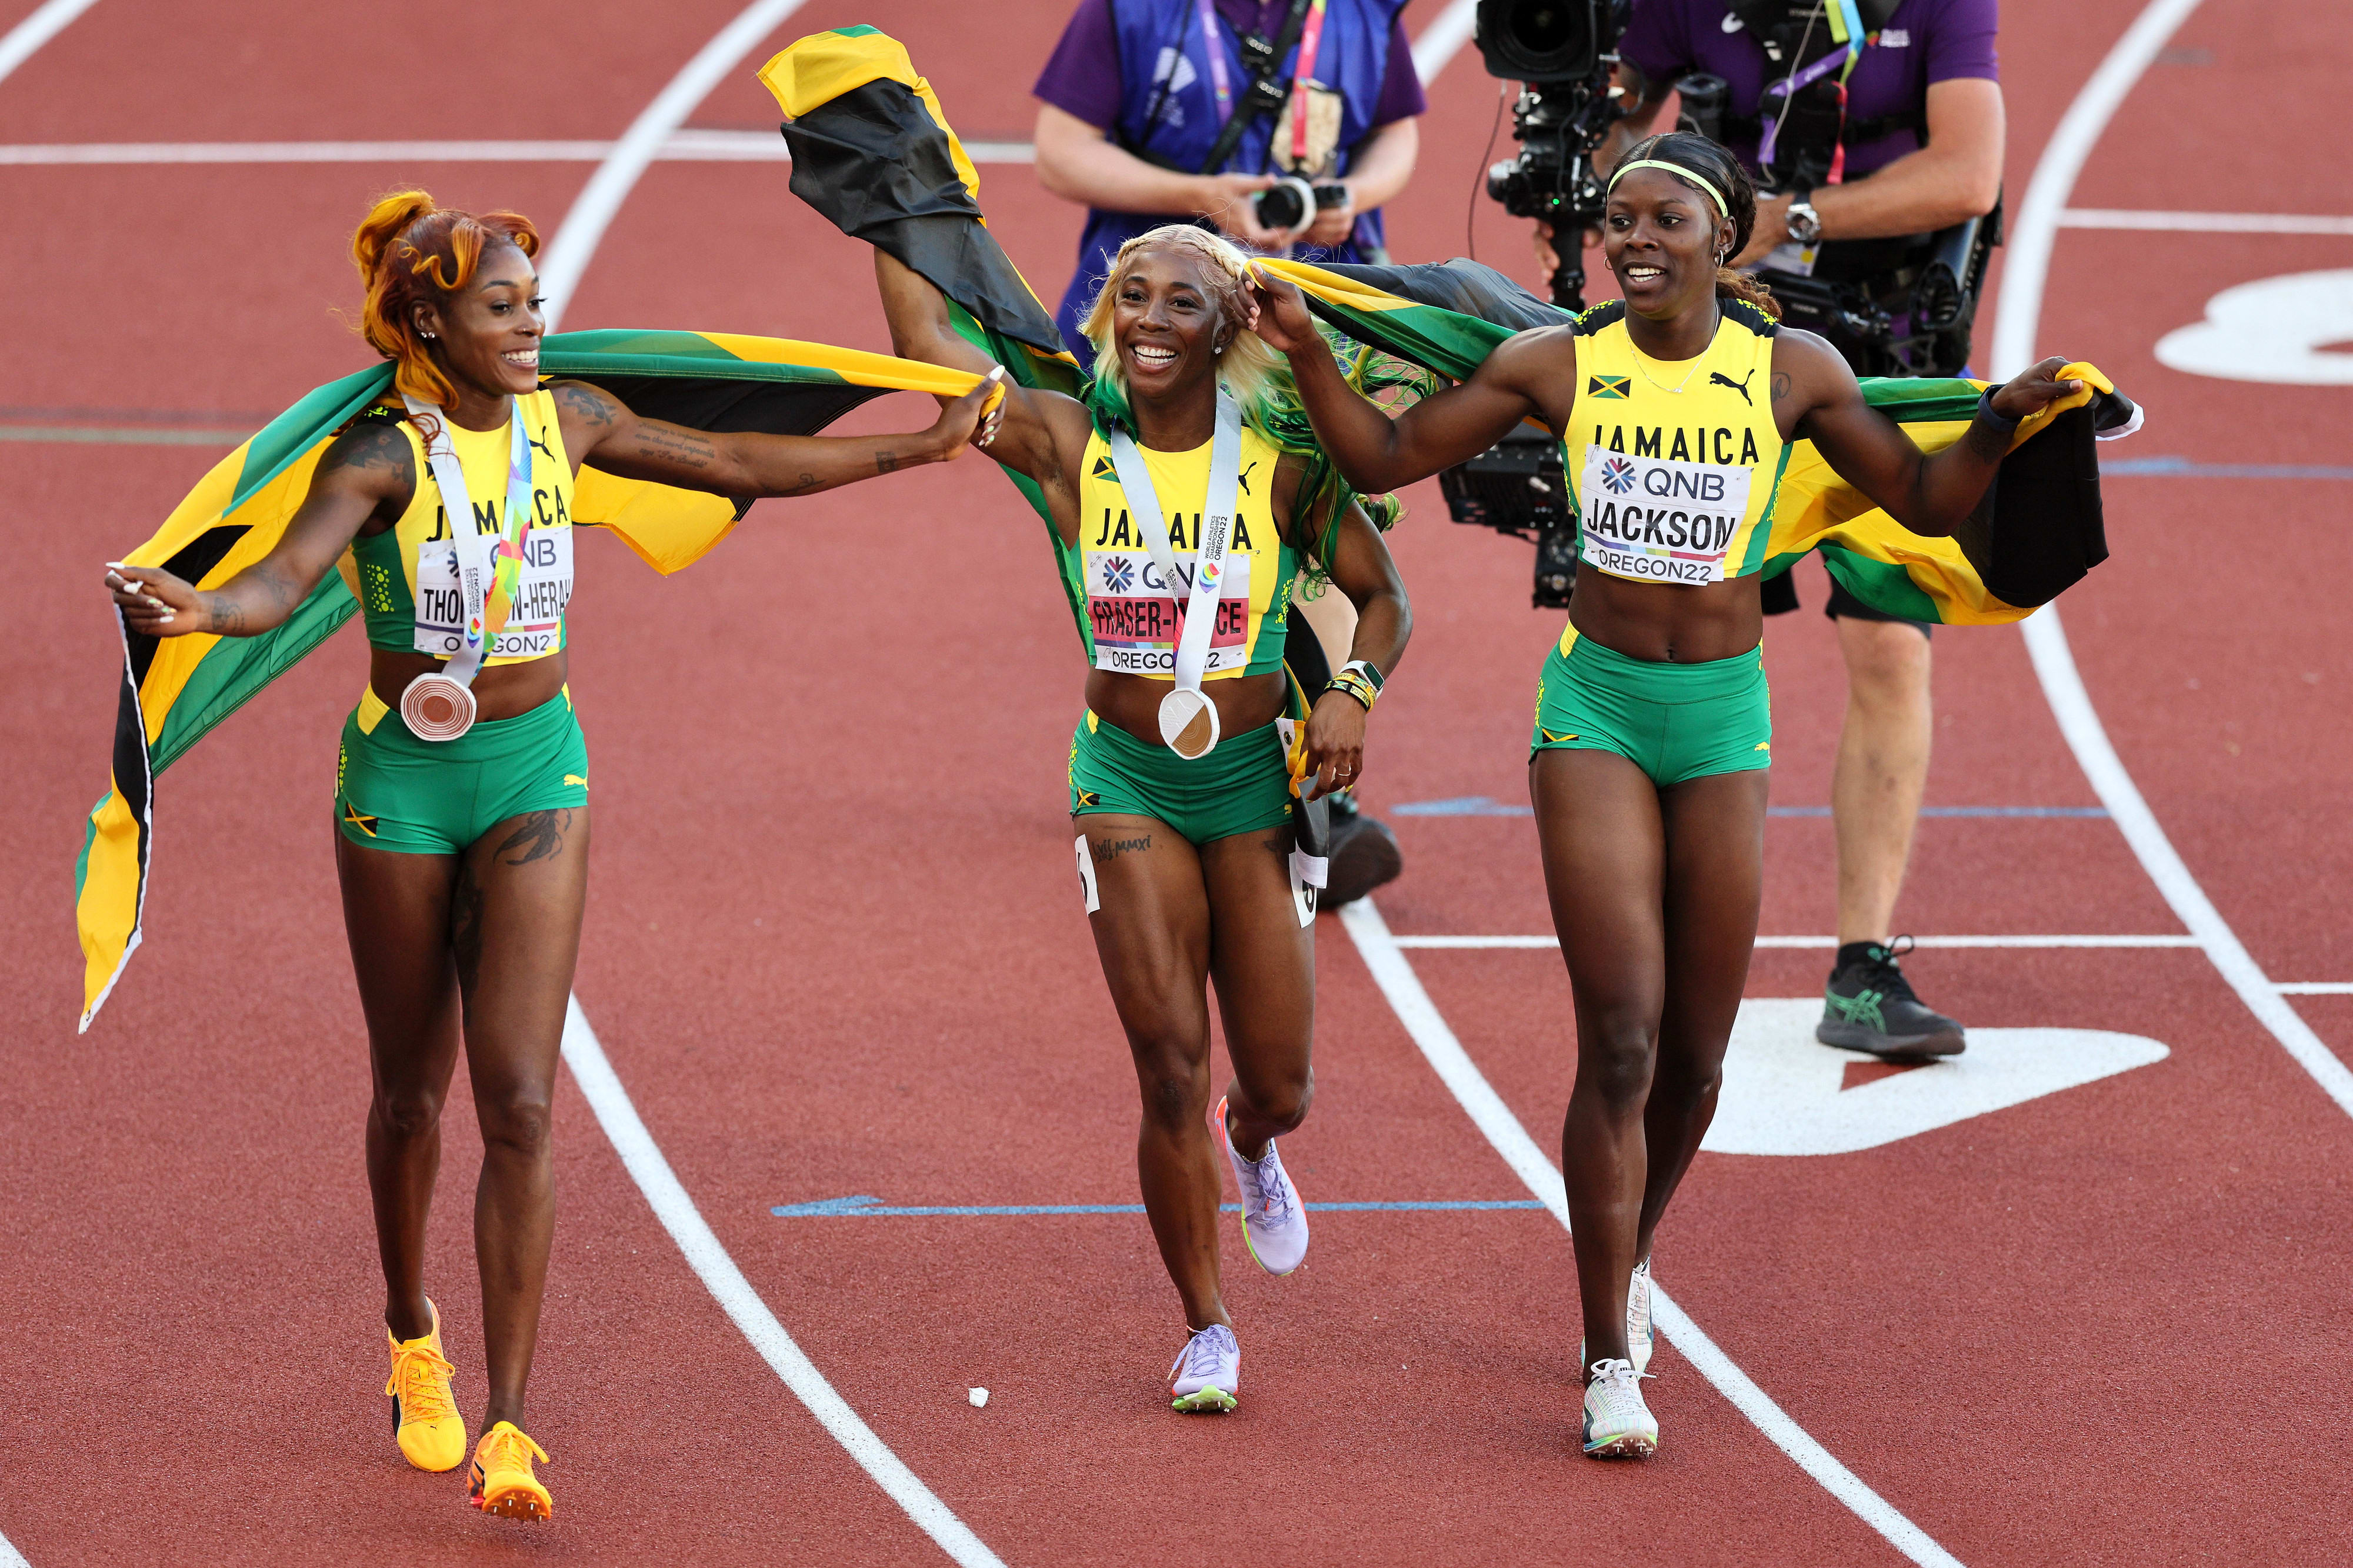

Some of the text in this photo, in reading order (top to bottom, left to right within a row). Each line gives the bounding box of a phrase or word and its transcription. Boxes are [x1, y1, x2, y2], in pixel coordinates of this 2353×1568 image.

[1585, 425, 1759, 465] JAMAICA
[1644, 468, 1725, 501] QNB
[425, 485, 568, 542] JMCA
[1096, 508, 1252, 550] JAAIA
[1208, 515, 1216, 541] ATHLETICS
[1587, 498, 1735, 551] JACKSON
[1209, 516, 1221, 559] CHAMPIONSHIPS
[1142, 561, 1195, 589] QN
[1599, 549, 1712, 582] OREGON22
[1093, 601, 1242, 637] FRASER-CE
[1112, 652, 1220, 669] OREGO2
